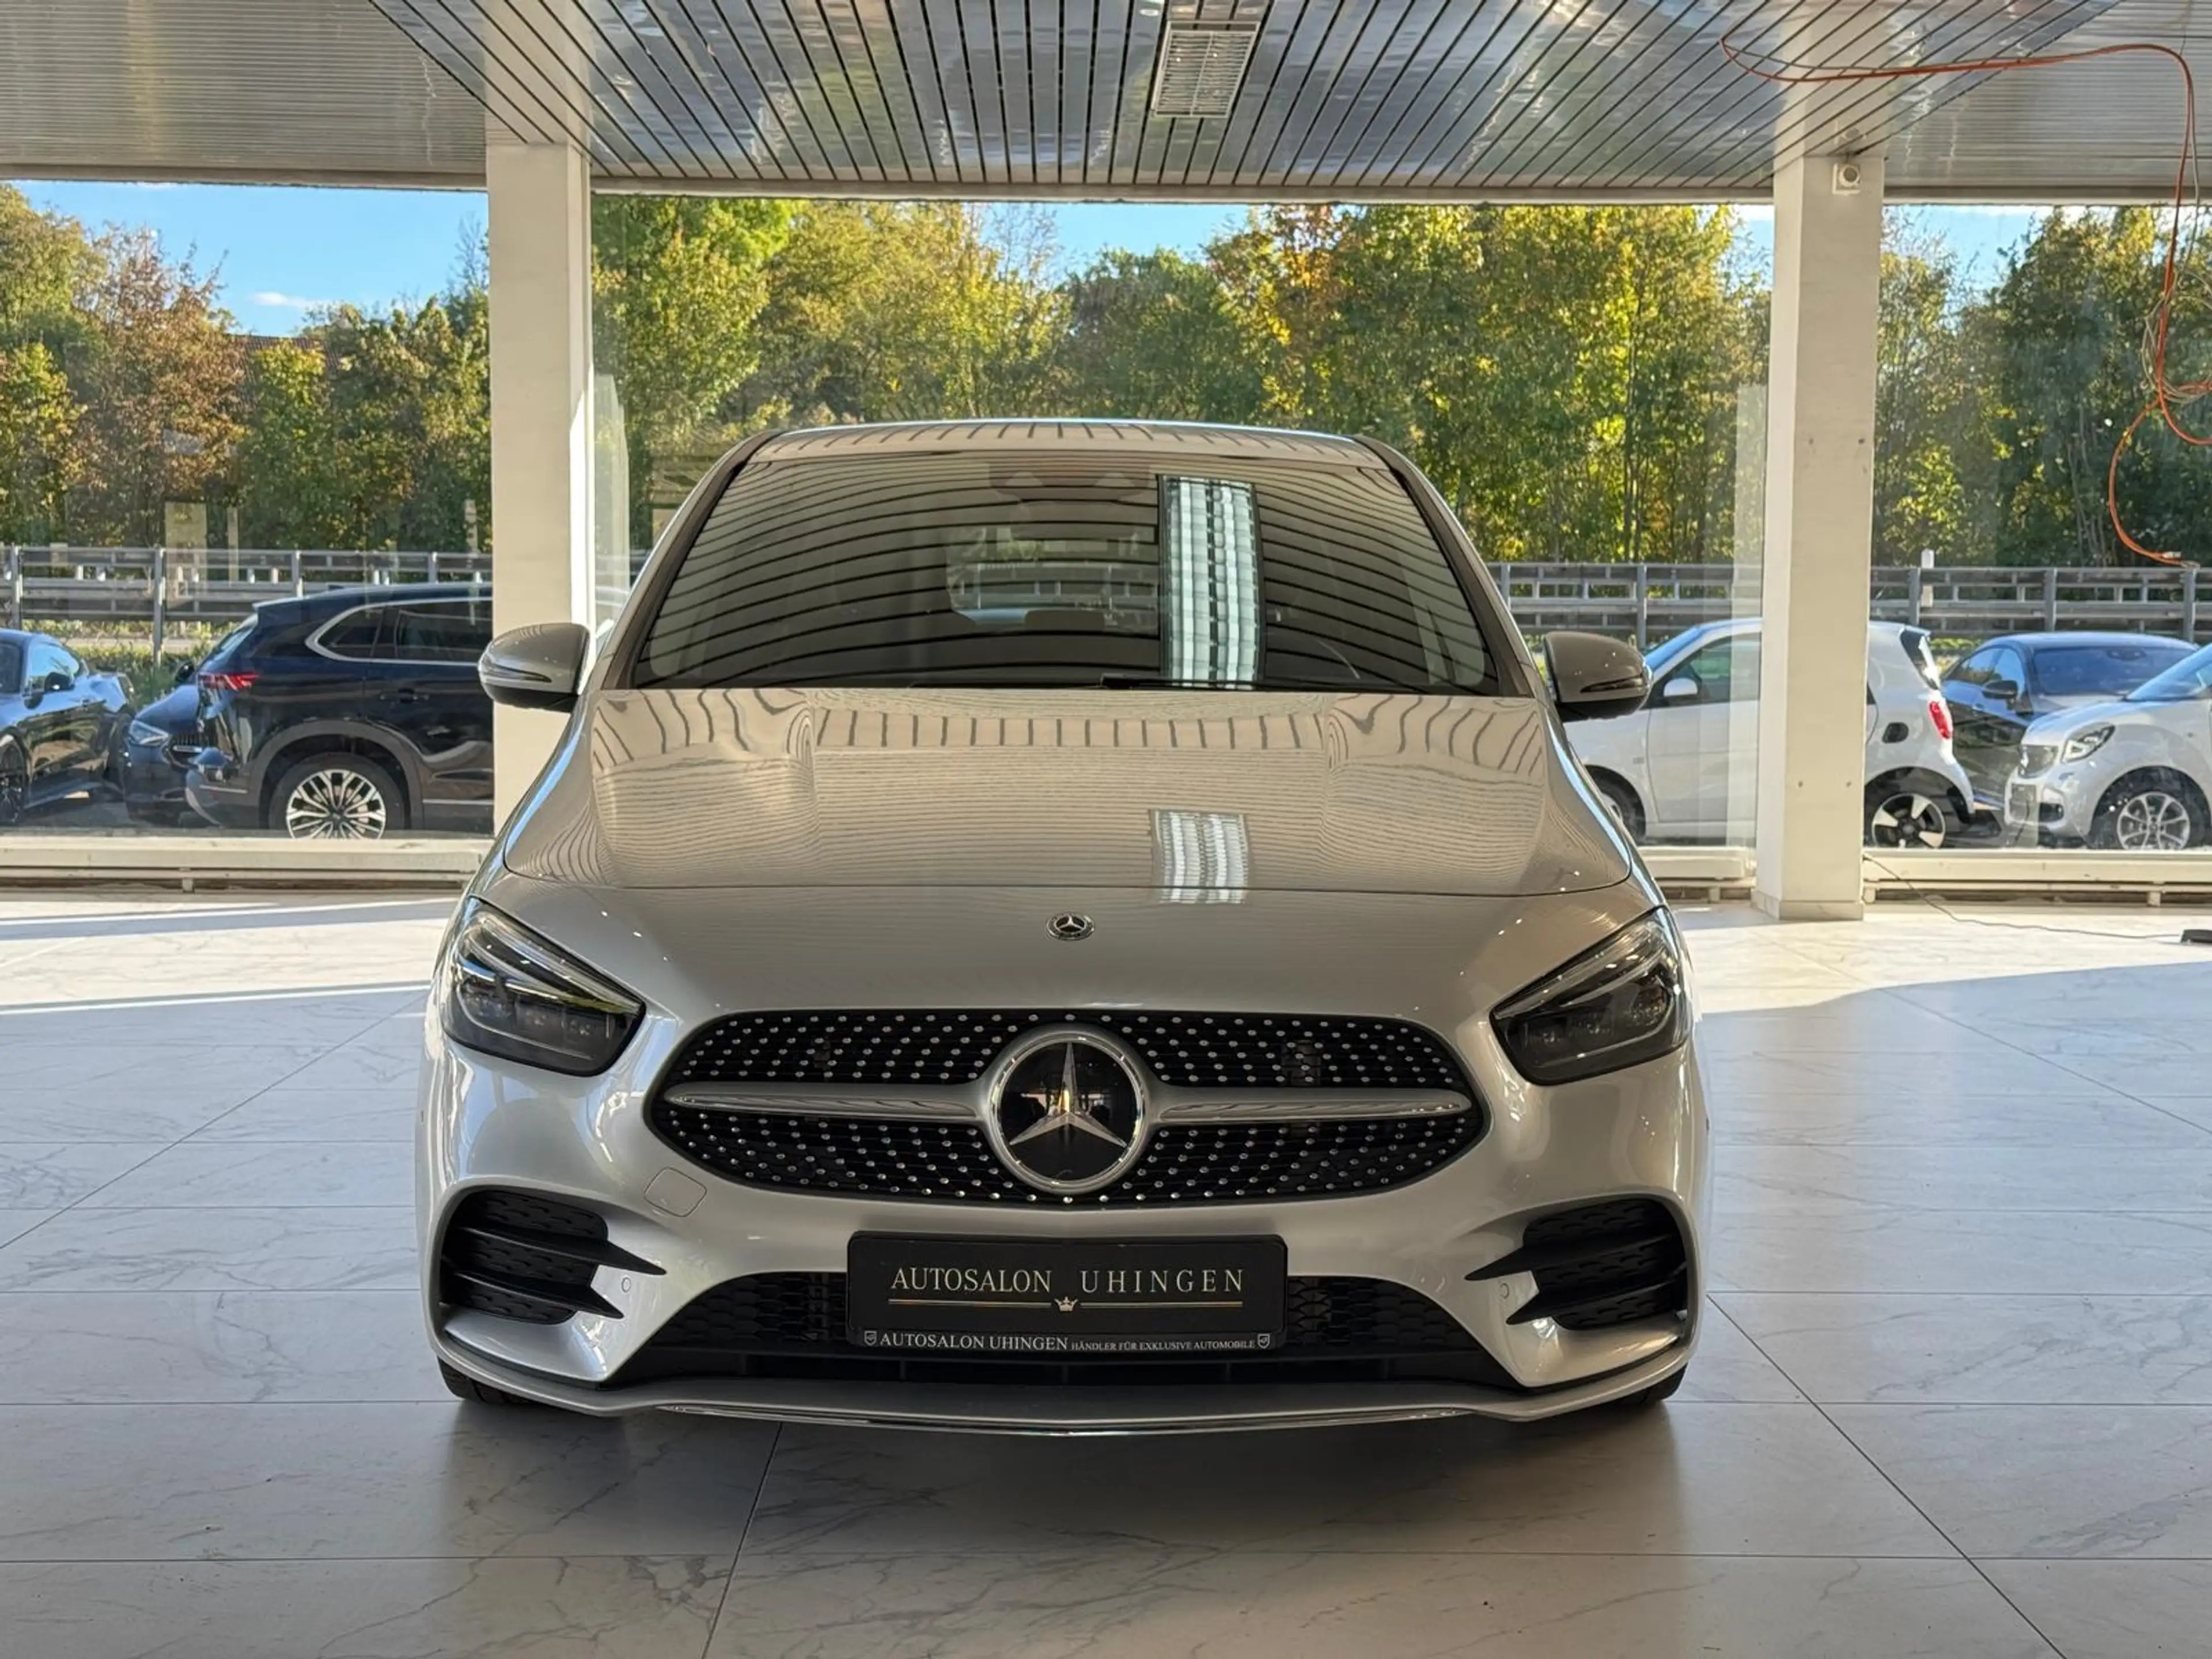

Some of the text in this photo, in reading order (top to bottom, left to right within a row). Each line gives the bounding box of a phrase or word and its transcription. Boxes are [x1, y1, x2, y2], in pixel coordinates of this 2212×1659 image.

[891, 1267, 1243, 1293] AUTOSALON UHINGEN
[880, 1332, 984, 1349] AUTOSALON
[989, 1336, 1068, 1350] UHINGEN
[1139, 1342, 1192, 1350] EXKLUSIVE
[1194, 1340, 1255, 1349] AUTOMOBILE
